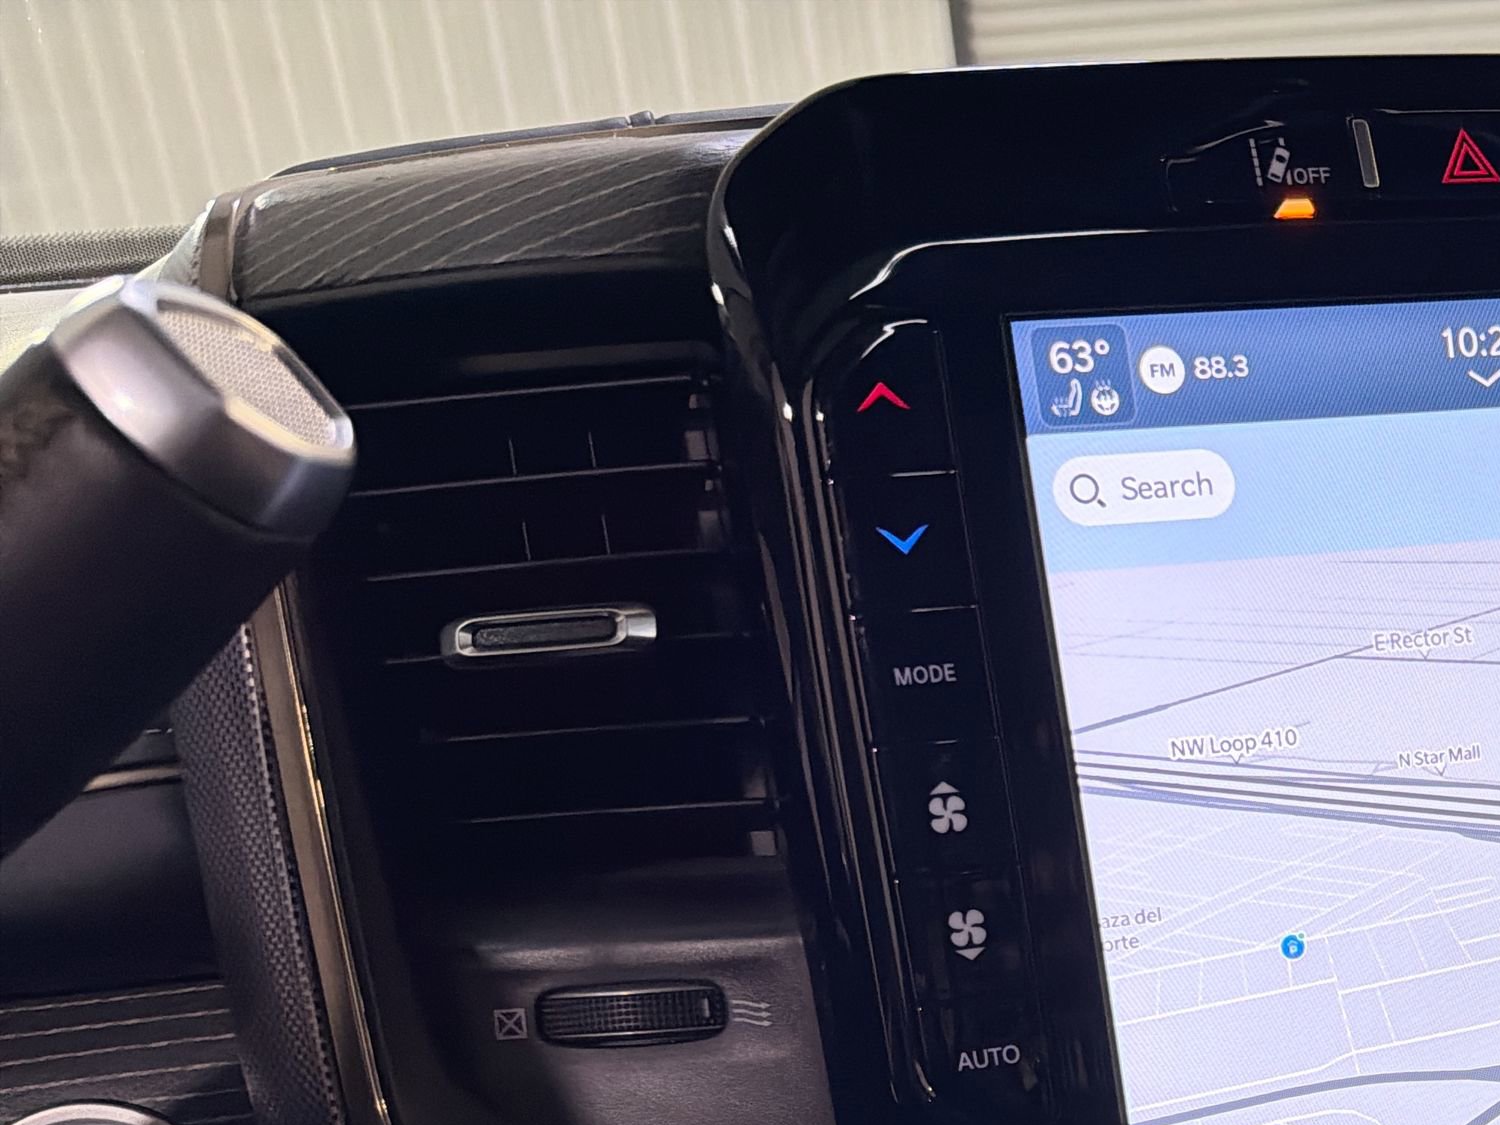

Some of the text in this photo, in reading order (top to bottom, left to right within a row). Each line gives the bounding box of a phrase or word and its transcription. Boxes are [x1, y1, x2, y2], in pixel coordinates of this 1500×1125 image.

[1294, 167, 1331, 184] OFF
[1149, 362, 1176, 378] FM
[1193, 354, 1250, 380] 88.3
[1120, 471, 1214, 501] Search
[1374, 627, 1473, 650] E Rector St
[893, 664, 957, 685] MODE
[1171, 729, 1297, 757] NW Loop 410
[1399, 745, 1481, 768] N Star Mall
[1134, 907, 1162, 926] del
[957, 1045, 1021, 1071] AUTO
